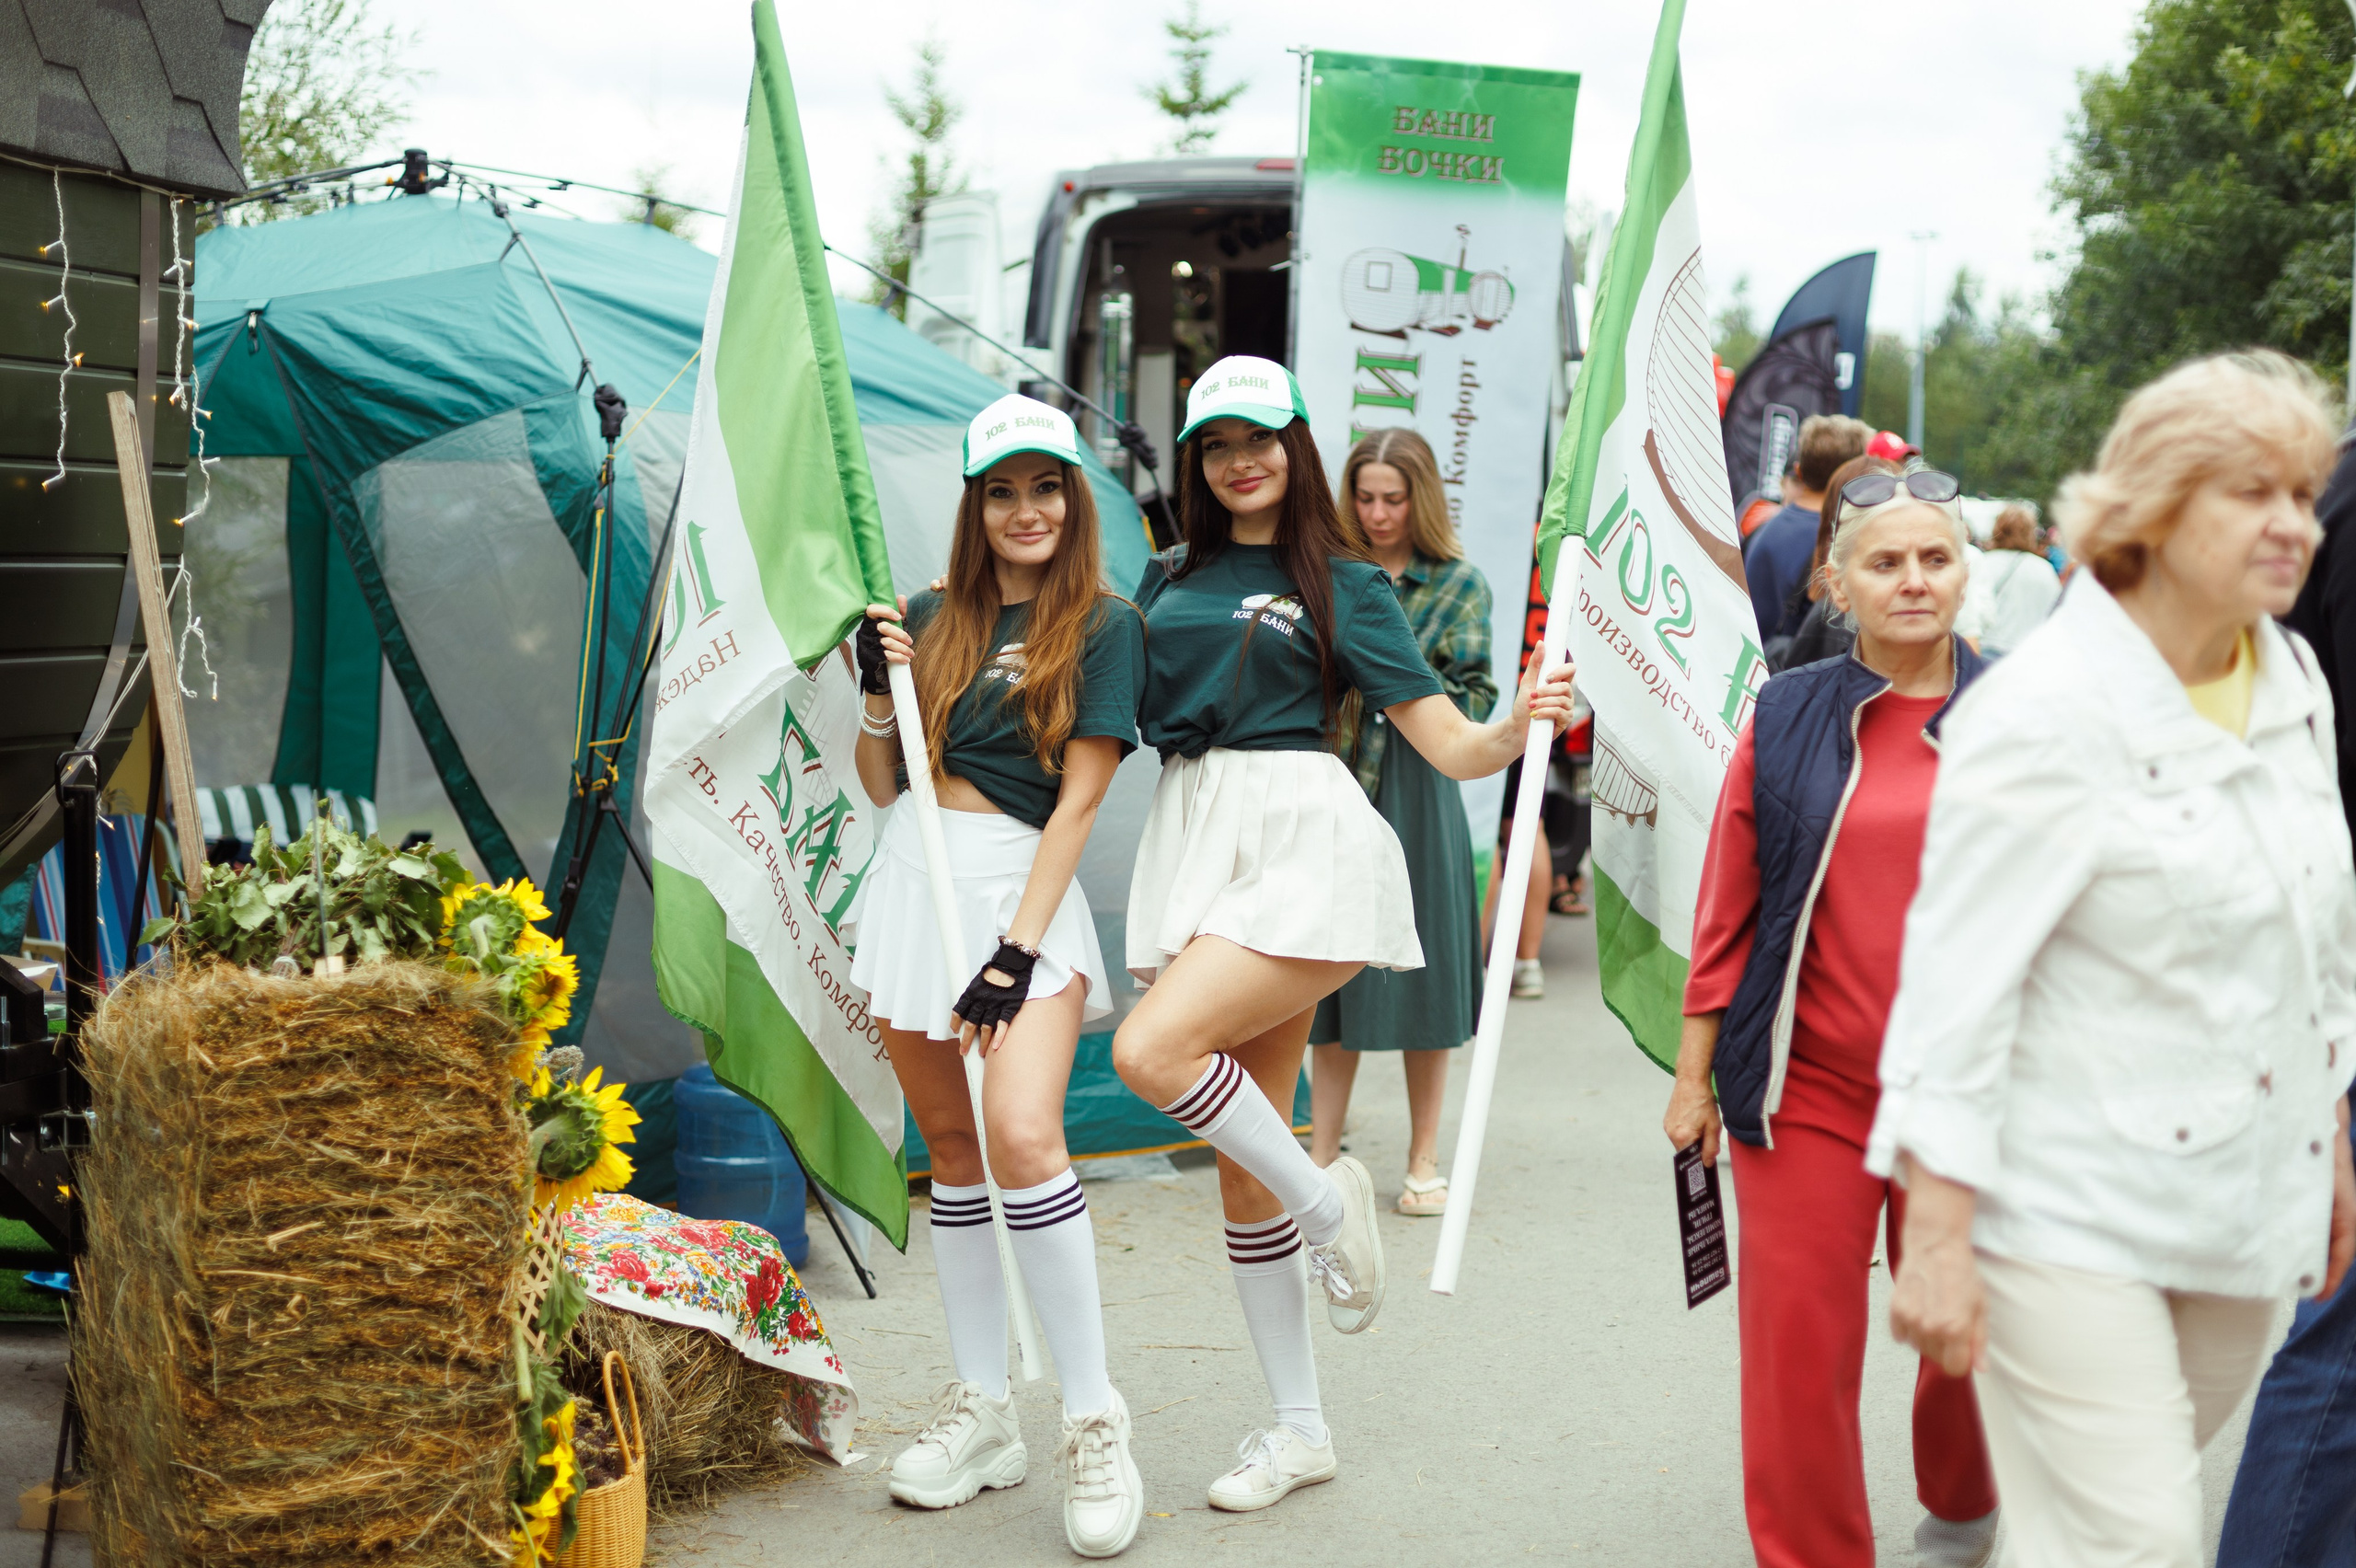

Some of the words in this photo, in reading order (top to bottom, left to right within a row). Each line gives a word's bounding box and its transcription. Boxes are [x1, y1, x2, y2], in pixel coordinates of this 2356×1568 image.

[1392, 105, 1496, 144] БАНИ
[1377, 144, 1506, 184] БОЧКИ
[1201, 381, 1220, 400] 102
[1228, 375, 1269, 390] БАНИ
[985, 421, 1008, 441] 102
[1014, 416, 1056, 431] БАНИ
[1443, 354, 1482, 487] Комфорт
[1583, 473, 1696, 682] 102
[1232, 610, 1253, 619] 102
[1259, 613, 1295, 637] БАНИ
[985, 668, 1004, 678] 102
[1578, 573, 1715, 750] роизводство
[727, 800, 801, 951] Качество.
[806, 942, 895, 1071] Комфор
[1688, 1198, 1715, 1221] МАНГАЛЫ
[1690, 1266, 1725, 1295] Башпечи
